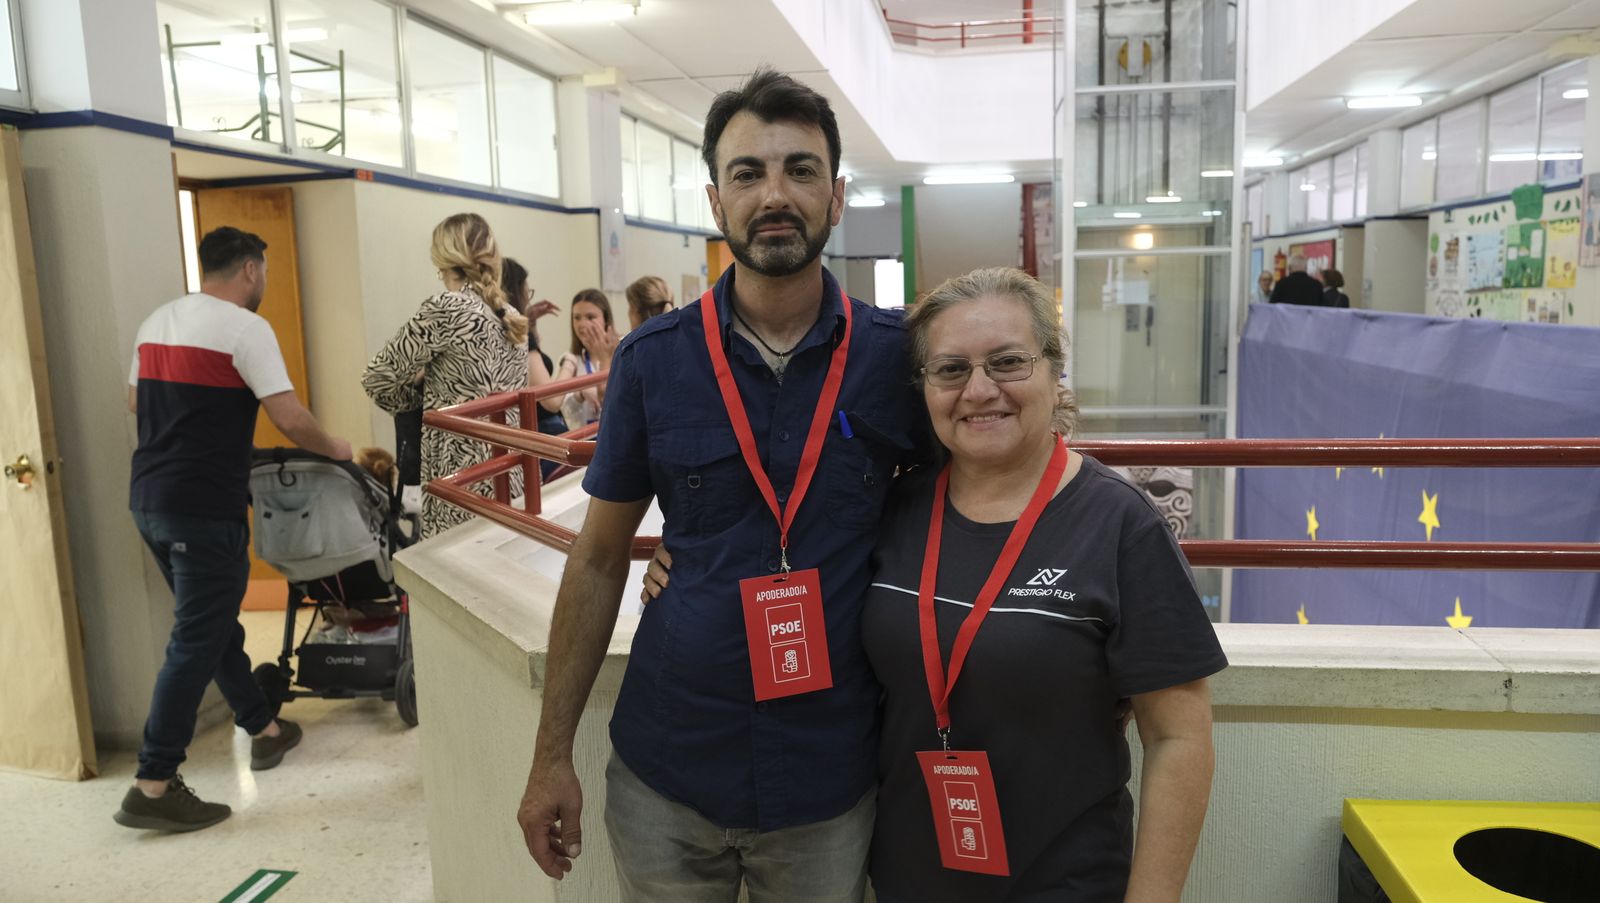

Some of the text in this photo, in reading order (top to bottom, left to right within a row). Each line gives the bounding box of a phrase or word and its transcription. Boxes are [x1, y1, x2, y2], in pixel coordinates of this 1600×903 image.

[756, 585, 808, 602] APODERADO/A
[1007, 587, 1077, 601] PRESTIGIO FLEX
[771, 620, 802, 636] PSOE
[325, 655, 352, 666] Oyster
[933, 765, 980, 776] APODERADO/A
[949, 798, 978, 811] PSOE
